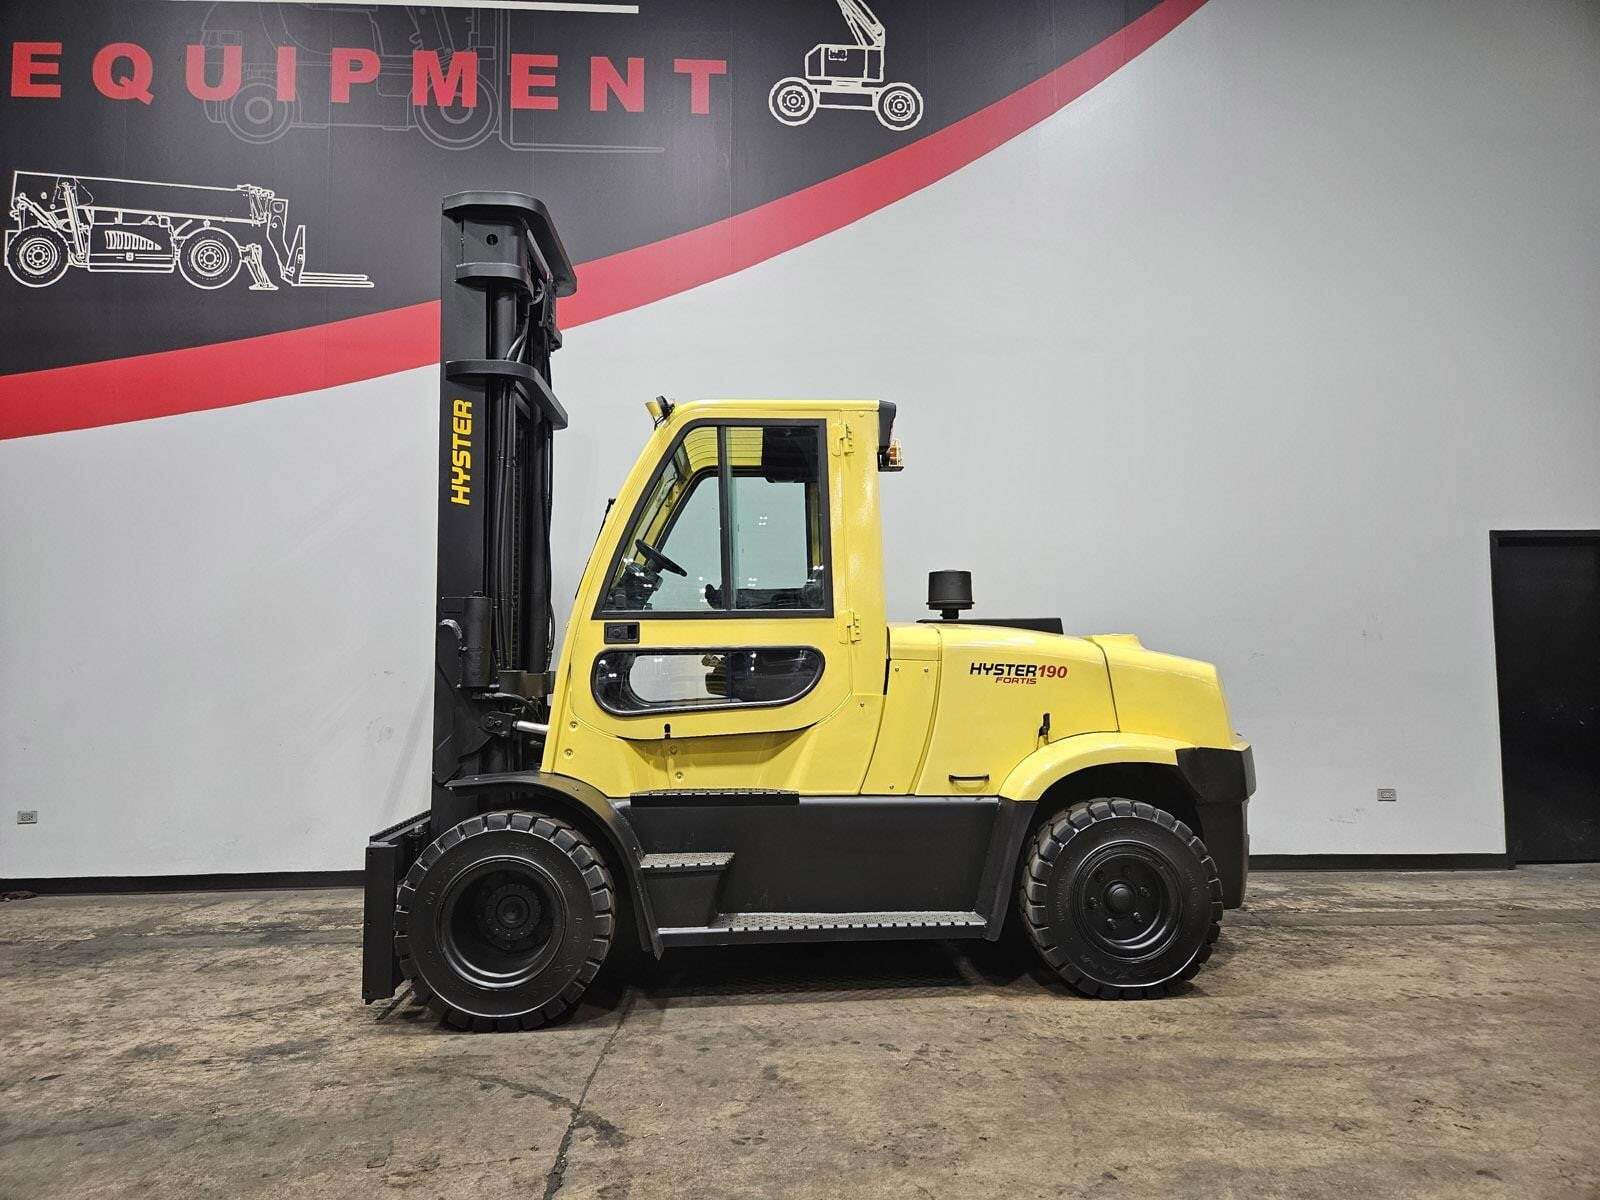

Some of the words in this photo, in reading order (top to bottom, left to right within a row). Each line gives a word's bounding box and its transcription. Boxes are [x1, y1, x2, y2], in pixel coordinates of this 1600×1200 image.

[10, 41, 728, 115] EQUIPMENT
[450, 399, 473, 506] HYSTER
[969, 662, 1037, 677] HYSTER
[1038, 664, 1068, 679] 190
[995, 676, 1037, 685] FORTIS
